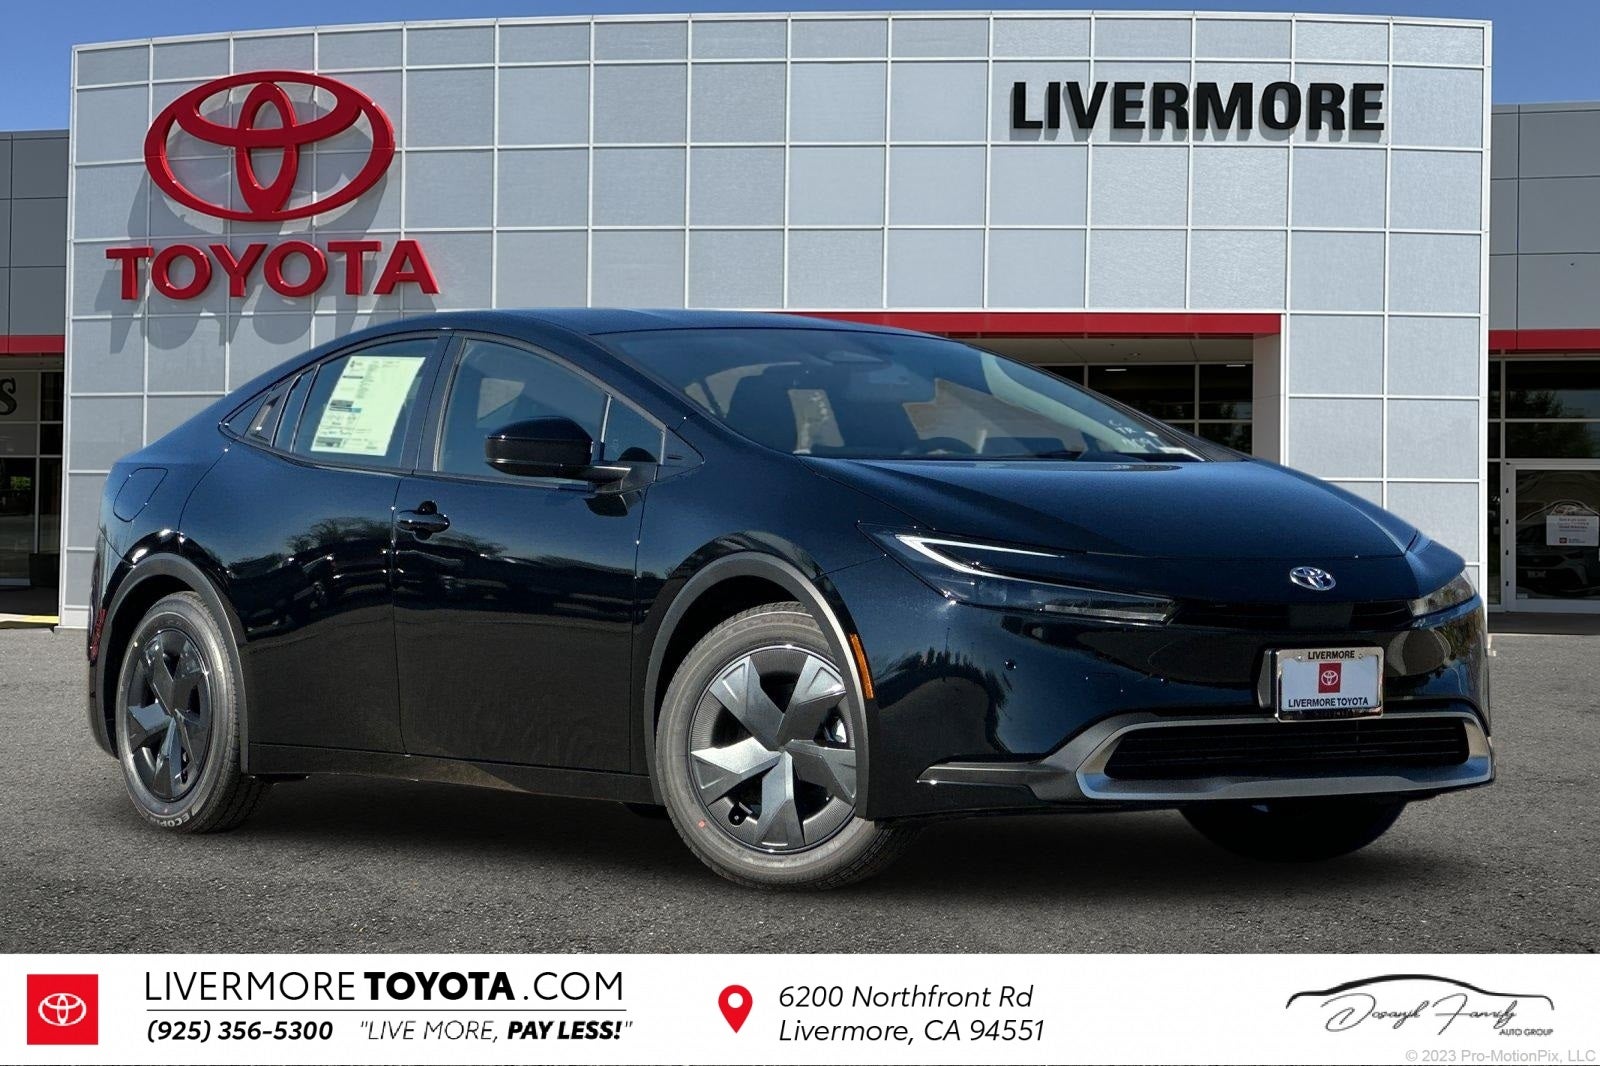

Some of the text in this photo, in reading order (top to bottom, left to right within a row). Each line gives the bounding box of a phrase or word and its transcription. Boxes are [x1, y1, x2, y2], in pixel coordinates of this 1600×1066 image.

[1013, 82, 1384, 130] LIVERMORE
[106, 239, 440, 300] TOYOTA
[1308, 650, 1355, 660] LIVERMORE
[1288, 696, 1369, 708] LIVERMORE TOYOTA
